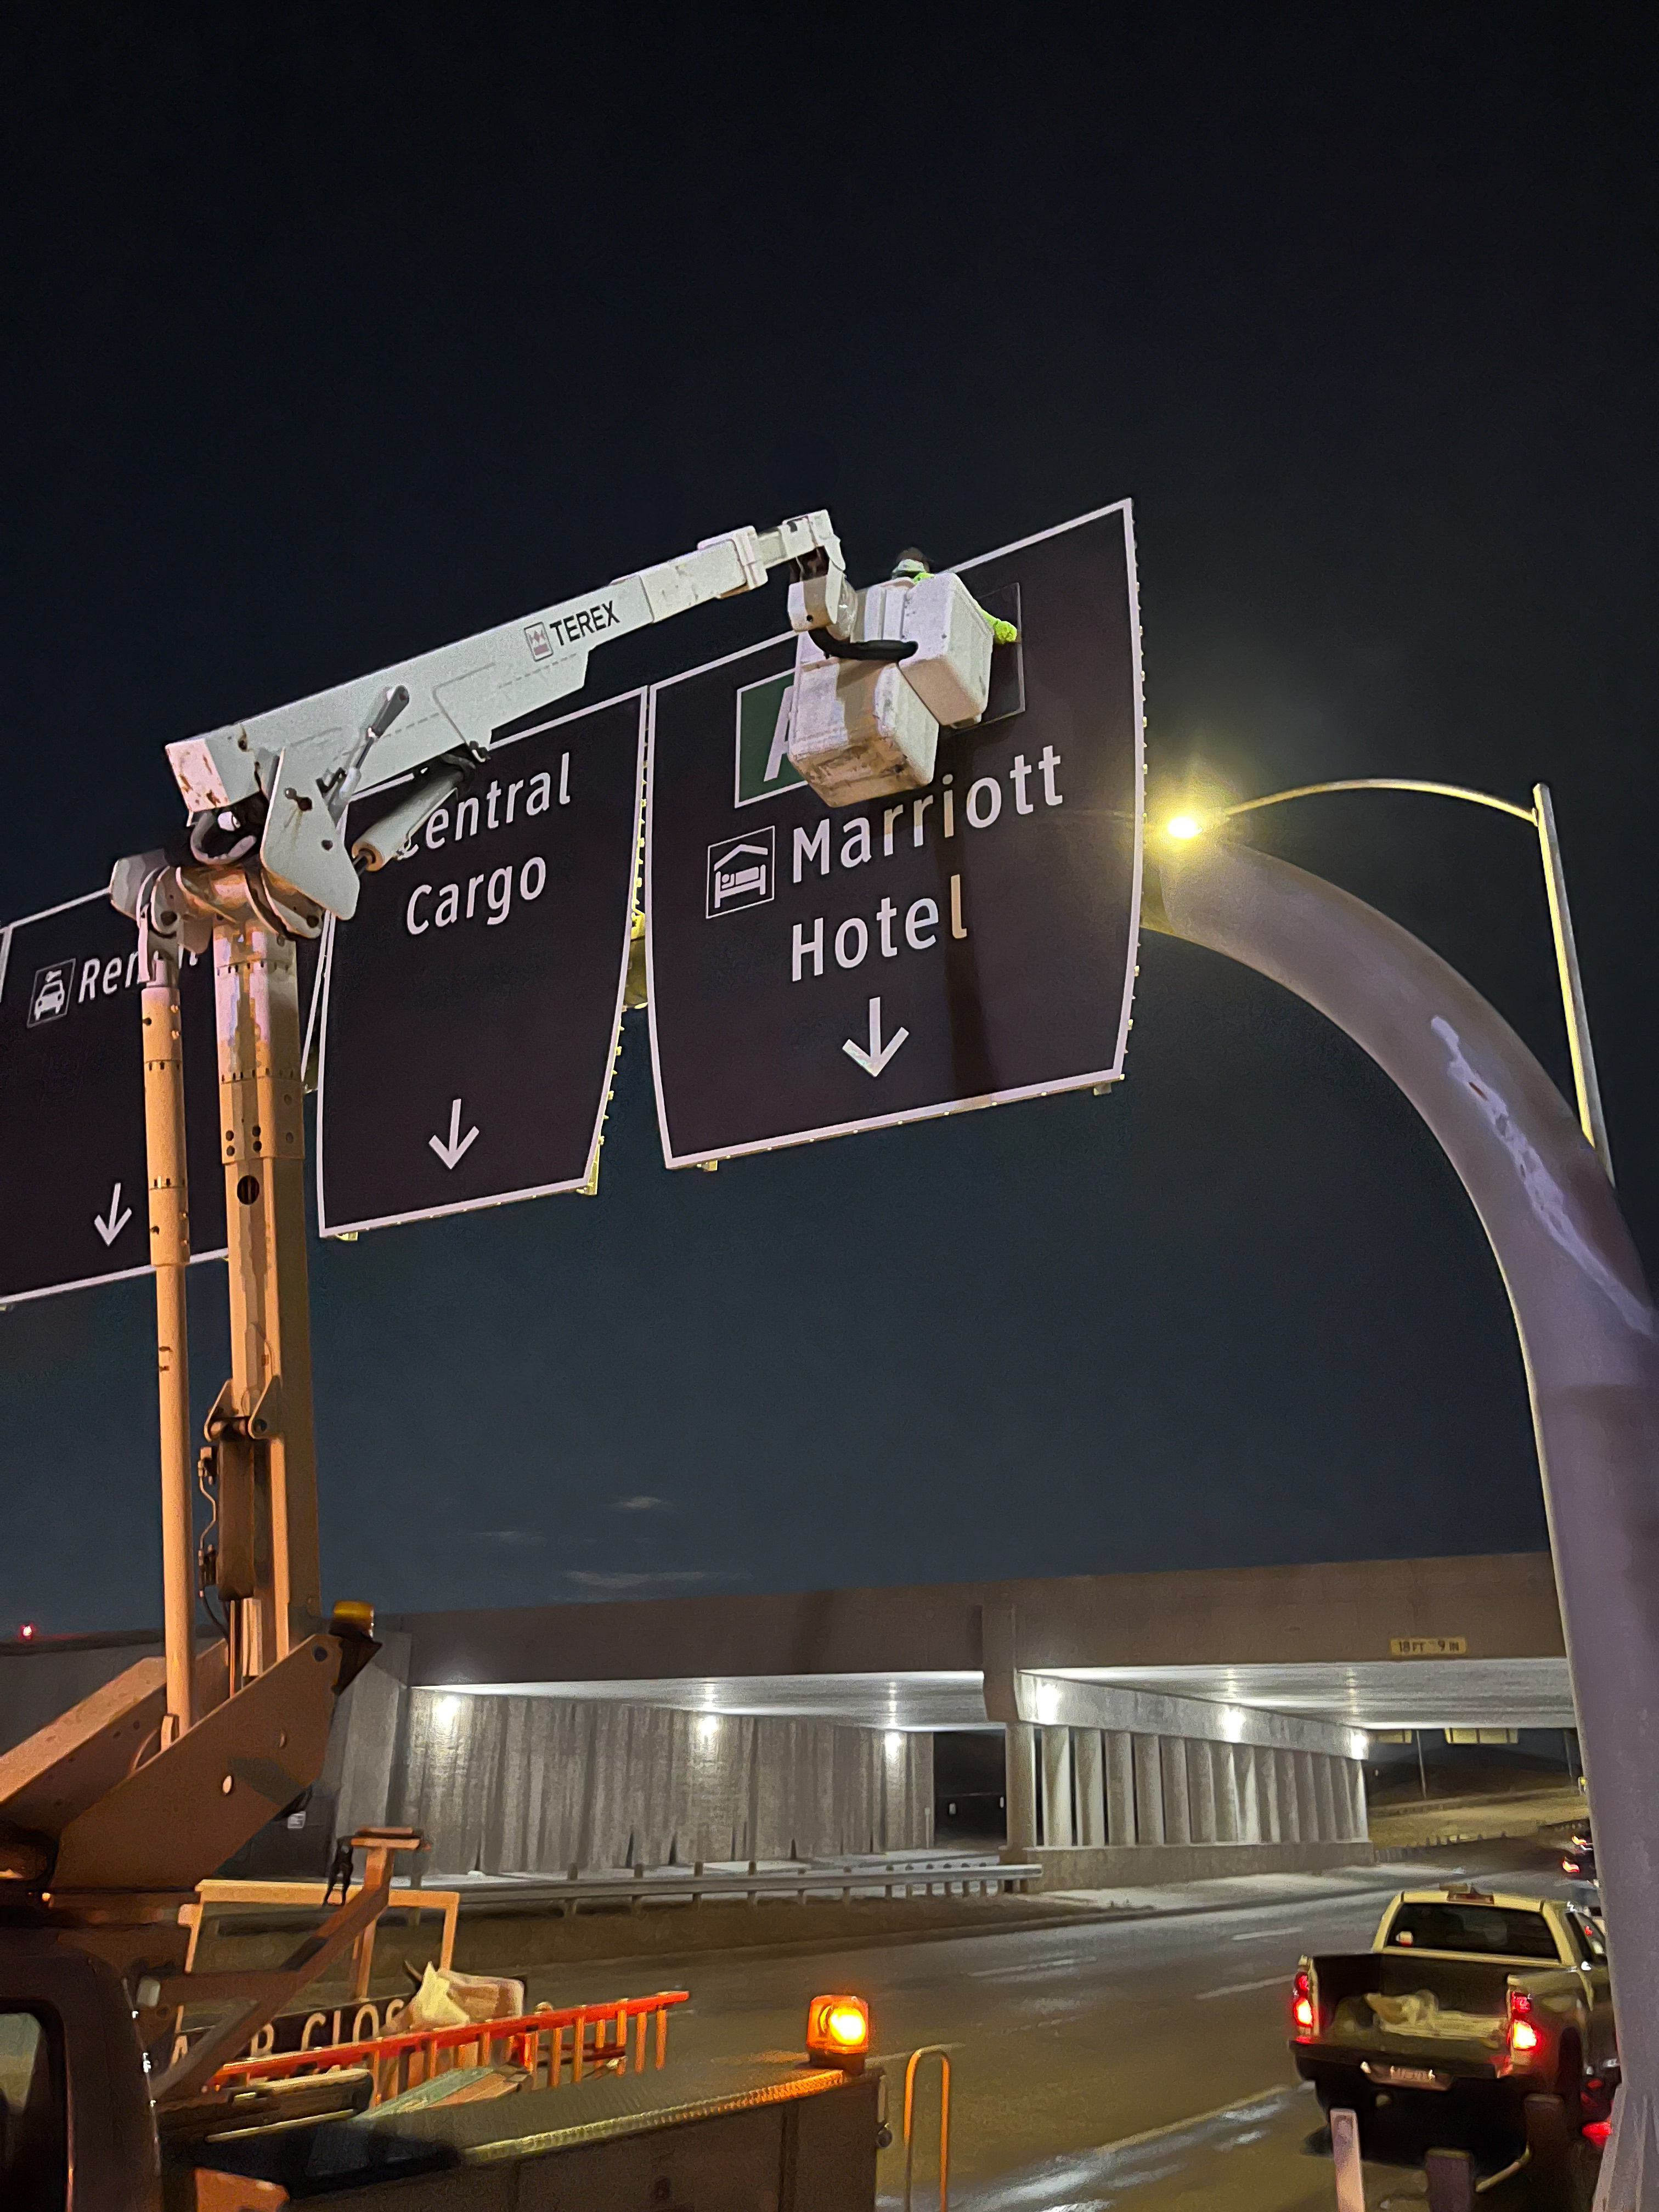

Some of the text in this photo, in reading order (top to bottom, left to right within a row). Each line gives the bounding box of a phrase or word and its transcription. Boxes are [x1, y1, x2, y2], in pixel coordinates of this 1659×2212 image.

[549, 600, 620, 646] TEREX
[396, 752, 571, 861] entral
[793, 745, 1063, 883] Marriott
[407, 856, 546, 935] Cargo
[792, 874, 967, 982] Hotel
